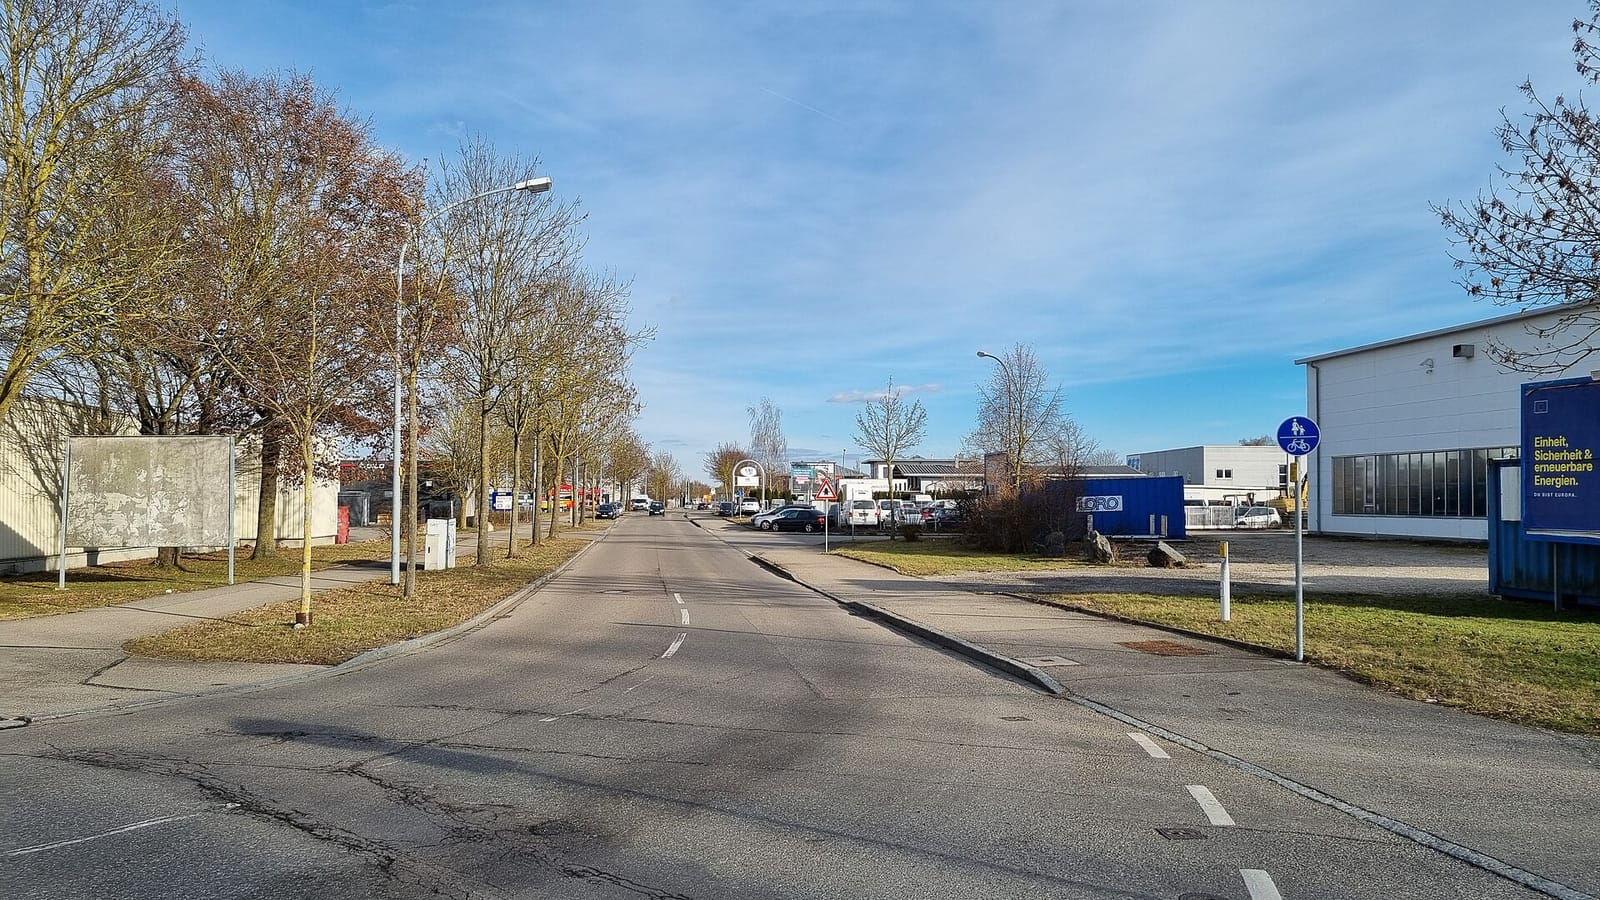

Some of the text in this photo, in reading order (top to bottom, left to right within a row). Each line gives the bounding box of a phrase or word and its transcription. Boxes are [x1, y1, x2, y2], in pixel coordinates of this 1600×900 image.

[1534, 435, 1568, 448] Einheit,
[1534, 449, 1592, 461] Sicherheit &
[1534, 461, 1593, 472] erneuerbare
[1534, 474, 1578, 488] Energien.
